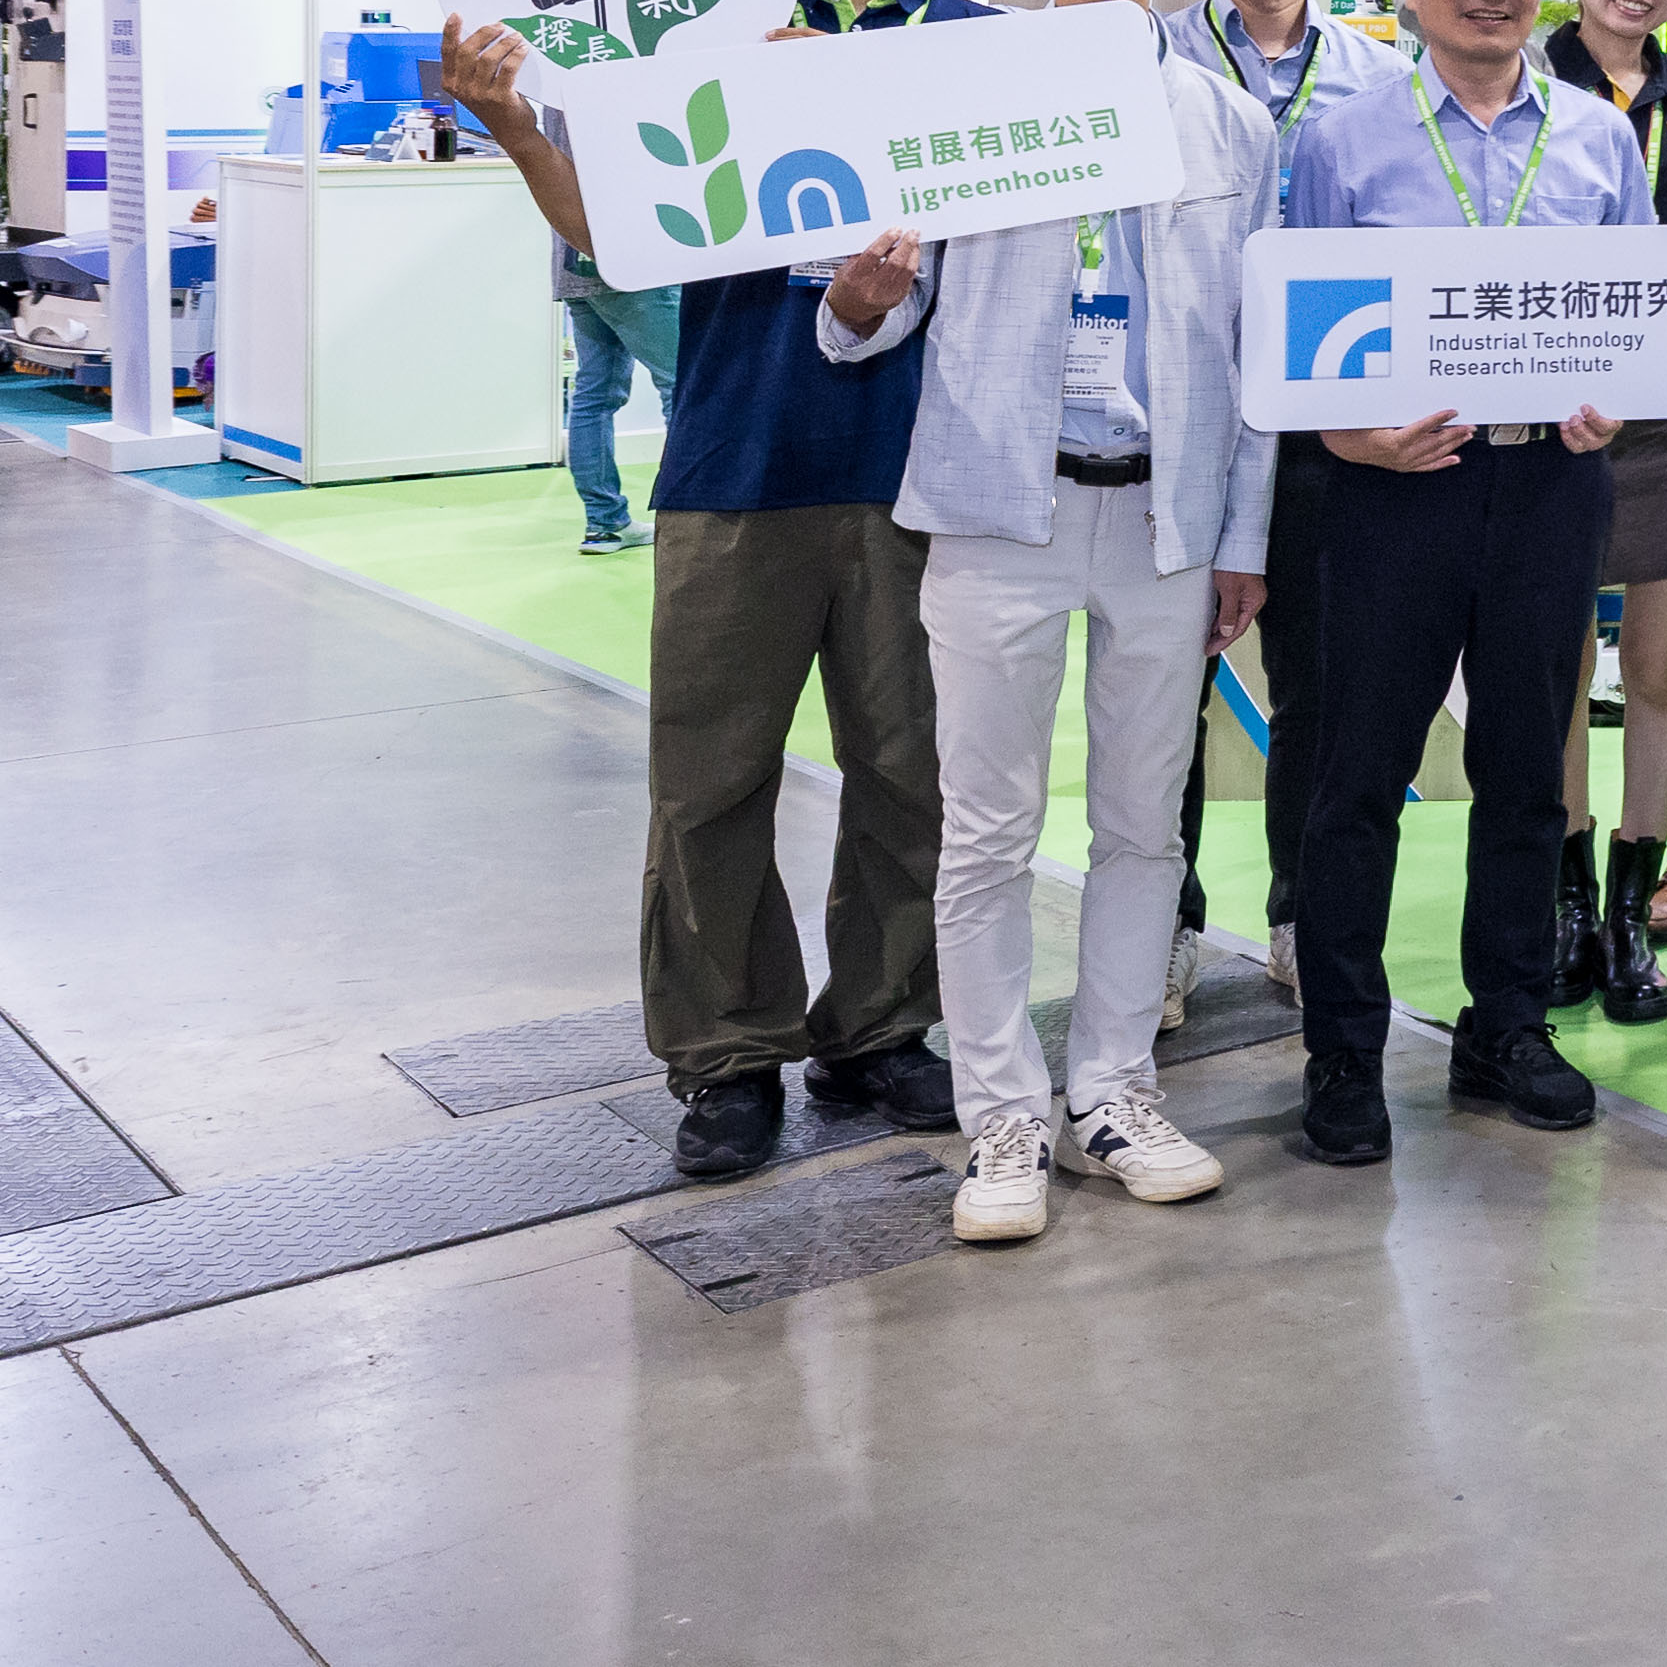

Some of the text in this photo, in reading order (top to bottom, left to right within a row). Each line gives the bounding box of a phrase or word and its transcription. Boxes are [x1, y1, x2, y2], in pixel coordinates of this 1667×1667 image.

[531, 16, 616, 64] 探長
[887, 107, 1121, 172] 皆展有限公司
[899, 160, 1104, 214] jjgreenhouse
[1070, 313, 1128, 330] hibitor
[1429, 332, 1645, 354] Industrial Technology
[1429, 356, 1613, 377] Research Institute
